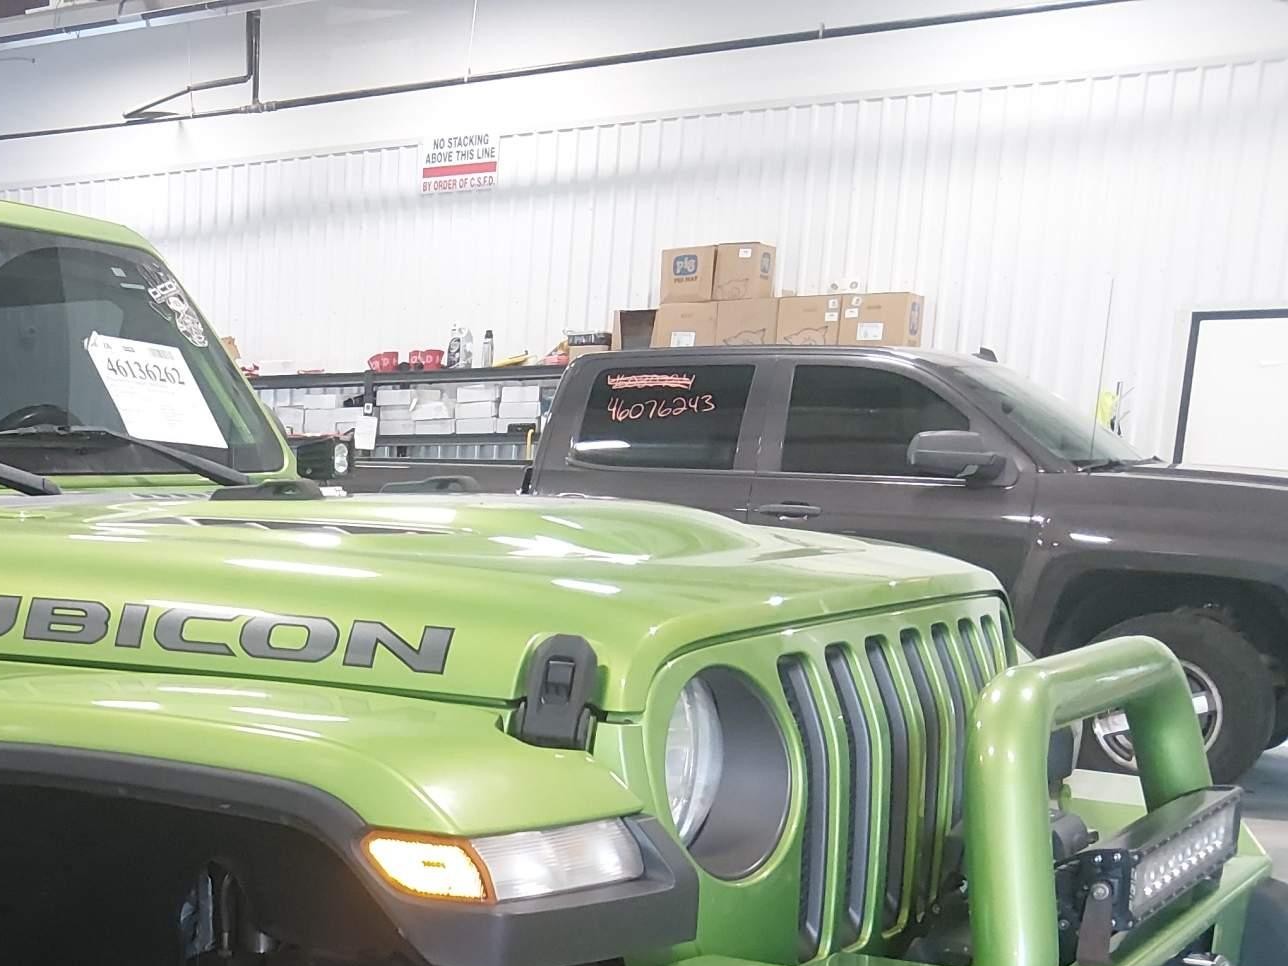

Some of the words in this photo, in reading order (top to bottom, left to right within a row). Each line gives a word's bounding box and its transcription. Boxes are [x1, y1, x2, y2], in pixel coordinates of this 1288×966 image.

[433, 138, 445, 150] NO
[447, 134, 489, 149] STACKING
[425, 151, 453, 165] ABOVE
[456, 149, 474, 161] THIS
[477, 147, 495, 160] LINE
[422, 182, 432, 192] BY
[433, 179, 457, 191] ORDER
[459, 178, 468, 188] OF
[470, 176, 495, 188] C.S.F.D.
[107, 357, 185, 385] 46136262
[608, 394, 715, 421] 46076243
